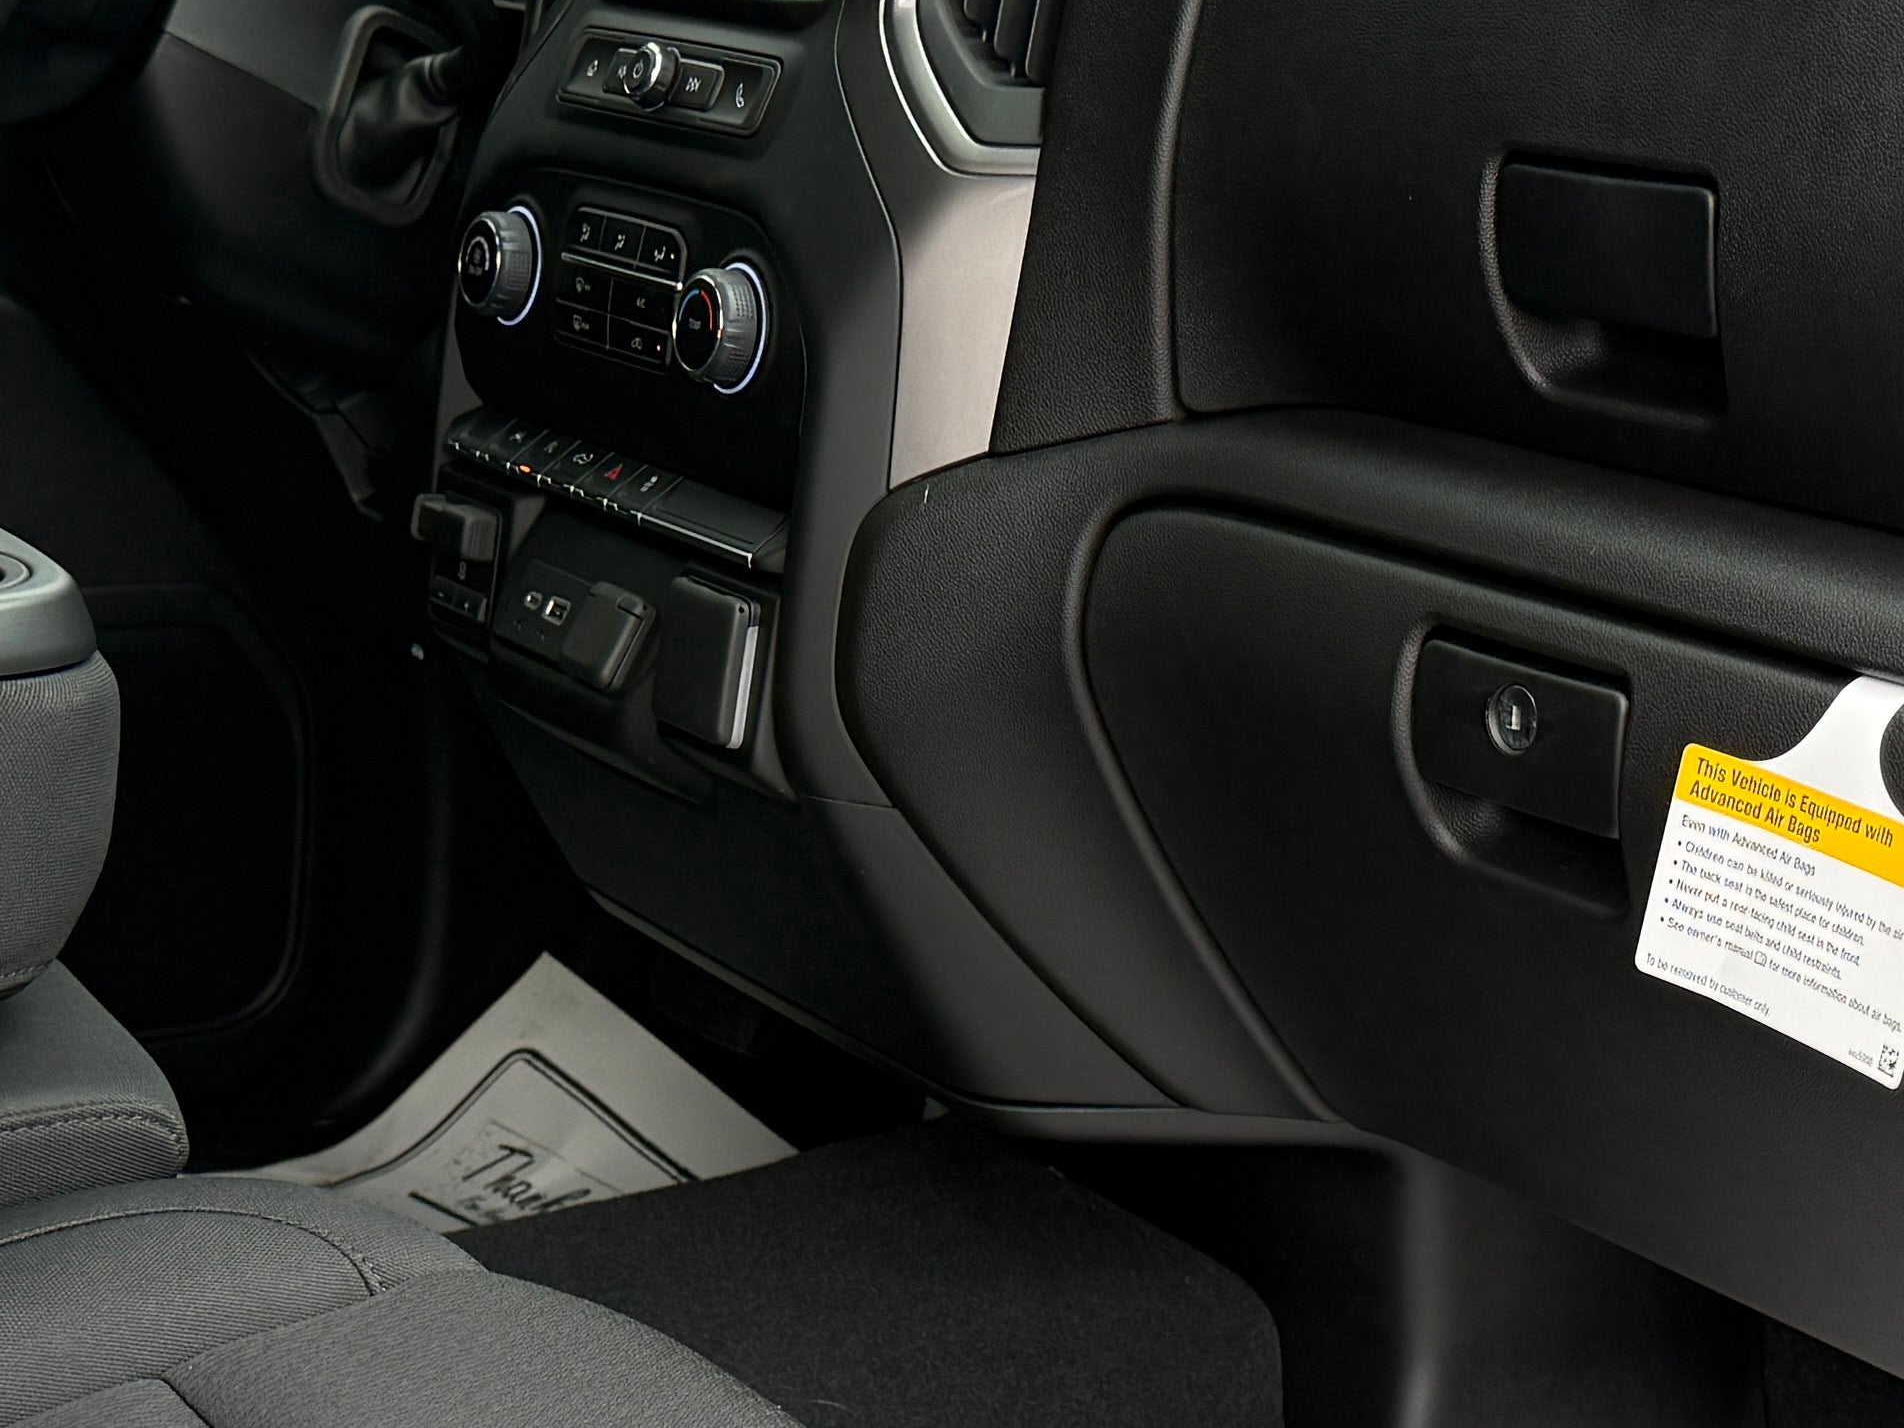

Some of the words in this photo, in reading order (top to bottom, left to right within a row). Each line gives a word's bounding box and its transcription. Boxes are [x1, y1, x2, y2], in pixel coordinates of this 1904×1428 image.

[1688, 779, 1764, 820] Advanced
[1763, 806, 1786, 829] Air
[1787, 813, 1821, 844] Bags
[1696, 756, 1727, 783] This
[1731, 768, 1782, 803] Vehicle
[1784, 788, 1797, 809] is
[1799, 793, 1863, 834] Equipped
[1865, 823, 1894, 849] with
